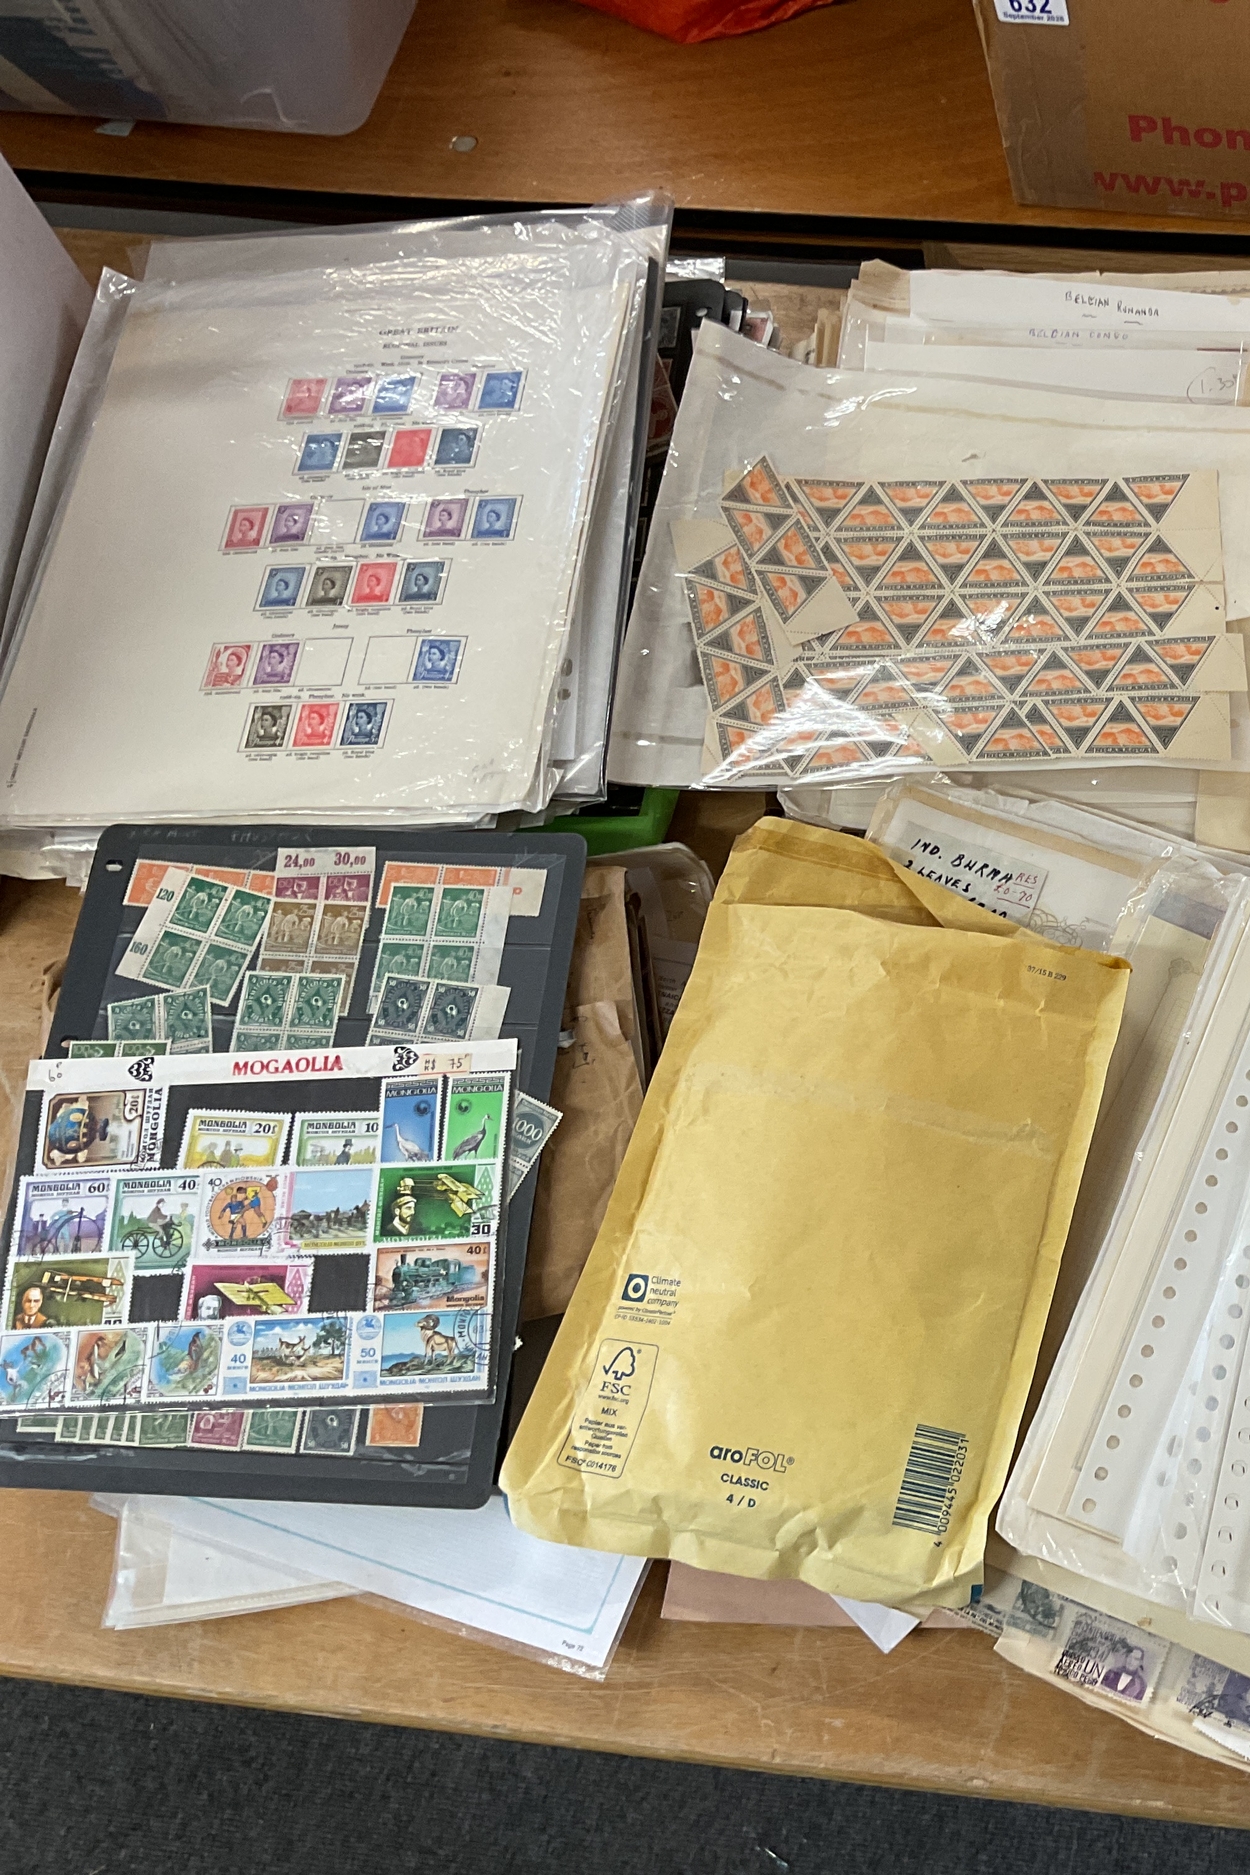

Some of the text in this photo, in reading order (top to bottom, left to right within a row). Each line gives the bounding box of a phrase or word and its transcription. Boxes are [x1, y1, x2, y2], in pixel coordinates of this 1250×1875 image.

[1009, 0, 1052, 14] 632
[911, 839, 941, 859] IND.
[284, 852, 366, 868] 24,00 30,00
[917, 867, 971, 893] LEAVES
[155, 888, 175, 902] 120
[129, 941, 148, 955] 160
[232, 1055, 343, 1076] MOGAOLIA
[386, 1087, 437, 1098] MONGOLIA
[452, 1083, 503, 1094] MONGOLIA
[198, 1119, 248, 1129] MONGOLIA
[306, 1121, 357, 1130] MONGOLIA
[31, 1182, 81, 1194] MONGOLIA
[122, 1179, 172, 1190] MONGOLIA
[472, 1223, 491, 1235] 30
[651, 1275, 681, 1287] Climate
[650, 1288, 677, 1297] neutral
[446, 1295, 485, 1303] Mongolia
[647, 1298, 679, 1308] company
[230, 1353, 247, 1364] 40
[360, 1348, 376, 1358] 50
[600, 1381, 631, 1396] FSC
[601, 1407, 618, 1416] MIX
[721, 1473, 769, 1491] CLASSIC
[937, 1488, 957, 1533] 009445
[950, 1438, 969, 1483] 022031
[726, 1494, 734, 1504] 4
[748, 1498, 756, 1508] D
[561, 1639, 576, 1650] Page
[1084, 1660, 1104, 1678] UN
